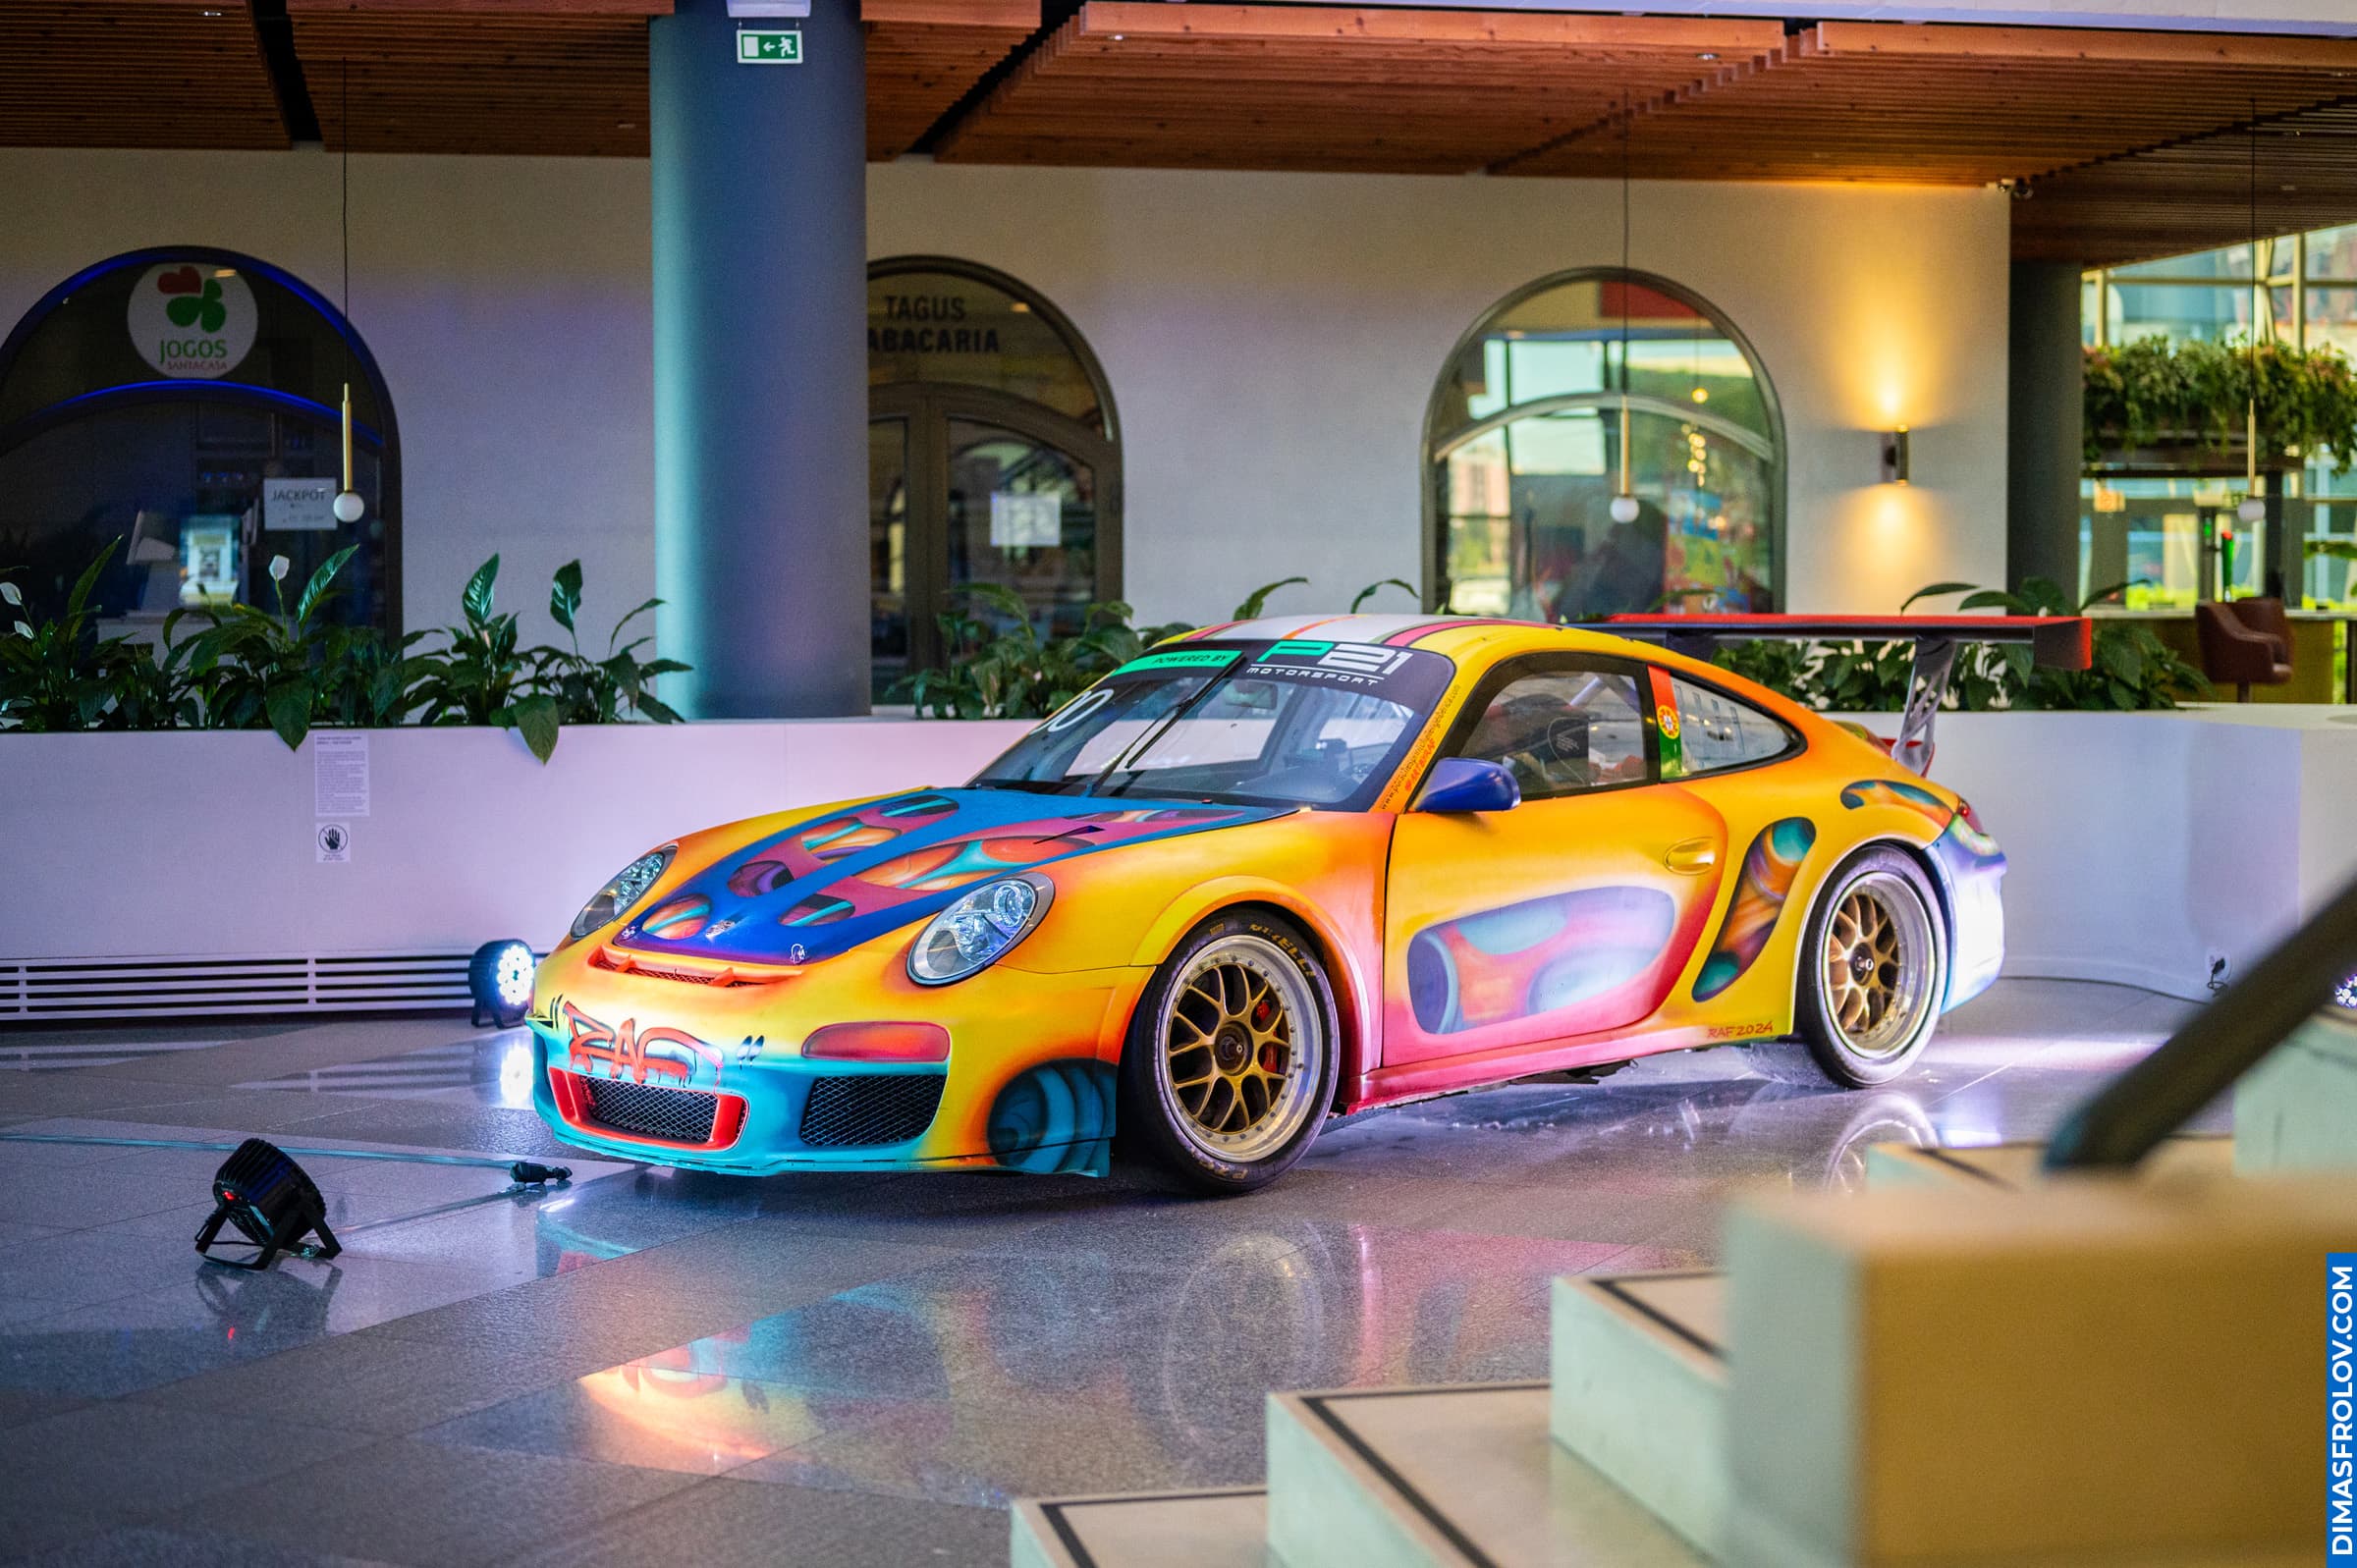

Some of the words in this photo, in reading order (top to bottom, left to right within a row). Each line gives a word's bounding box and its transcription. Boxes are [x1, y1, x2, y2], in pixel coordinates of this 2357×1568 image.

[885, 296, 965, 322] TAGUS
[867, 327, 1000, 352] ABACARIA
[159, 339, 228, 364] JOGOS
[272, 489, 327, 502] JACKPOT
[1152, 655, 1209, 665] POWERED
[1211, 654, 1228, 663] BY
[1256, 640, 1413, 676] P21
[1246, 667, 1379, 686] MOTORSPORT
[1707, 1025, 1734, 1039] RAF
[1736, 1021, 1774, 1036] 2024
